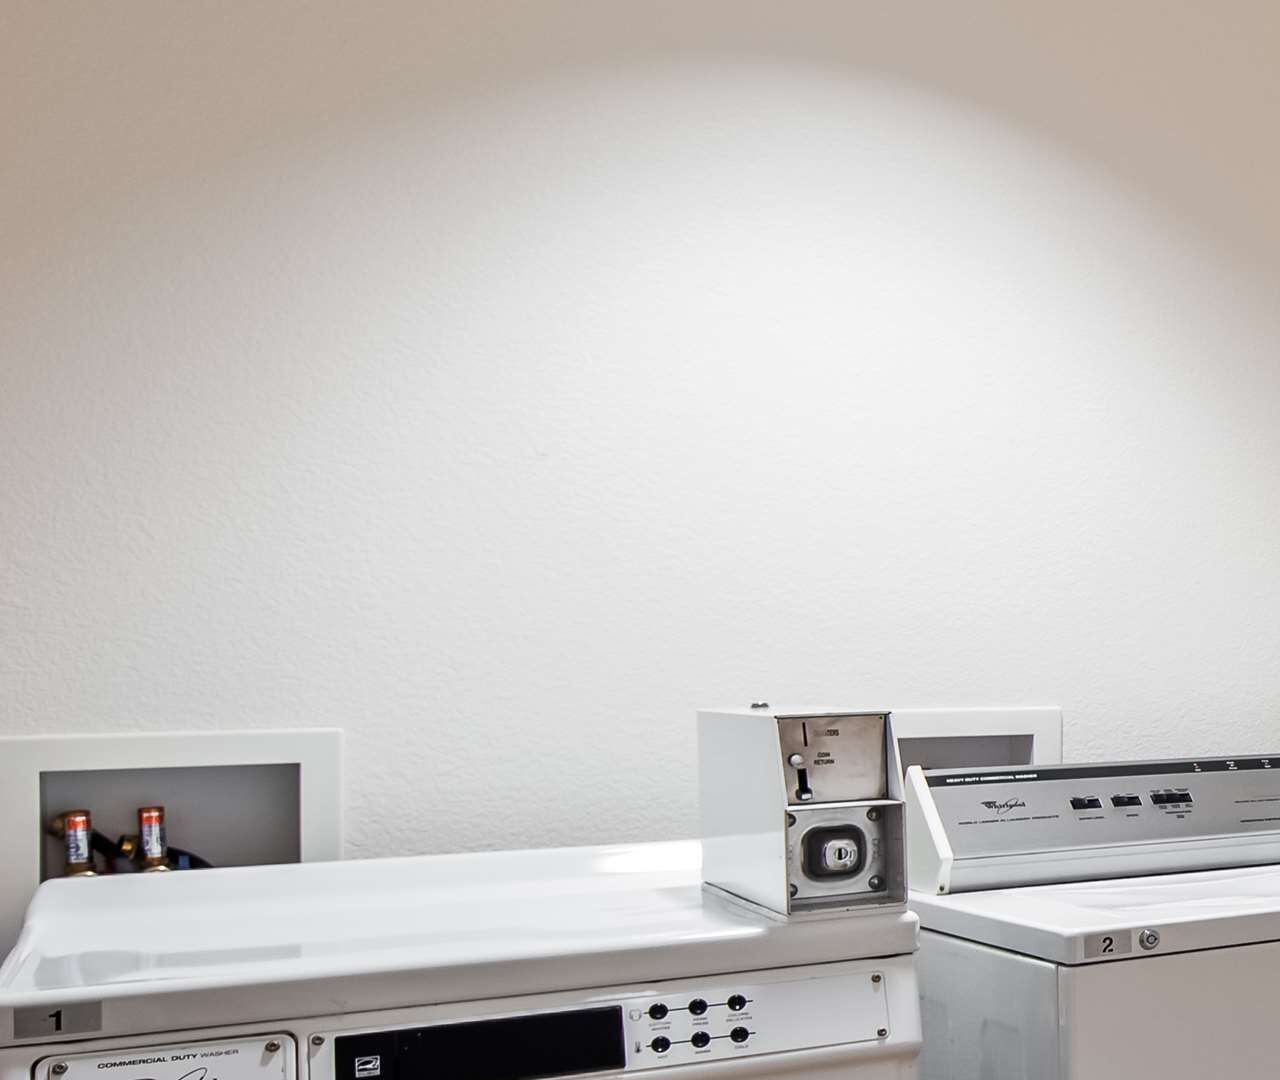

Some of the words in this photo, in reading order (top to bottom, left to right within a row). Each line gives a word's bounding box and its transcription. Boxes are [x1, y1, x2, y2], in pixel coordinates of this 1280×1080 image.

[1102, 936, 1114, 953] 2
[48, 1009, 62, 1031] 1
[97, 1056, 168, 1069] COMMERCIAL
[171, 1053, 198, 1062] DUTY
[200, 1049, 239, 1058] WASHER
